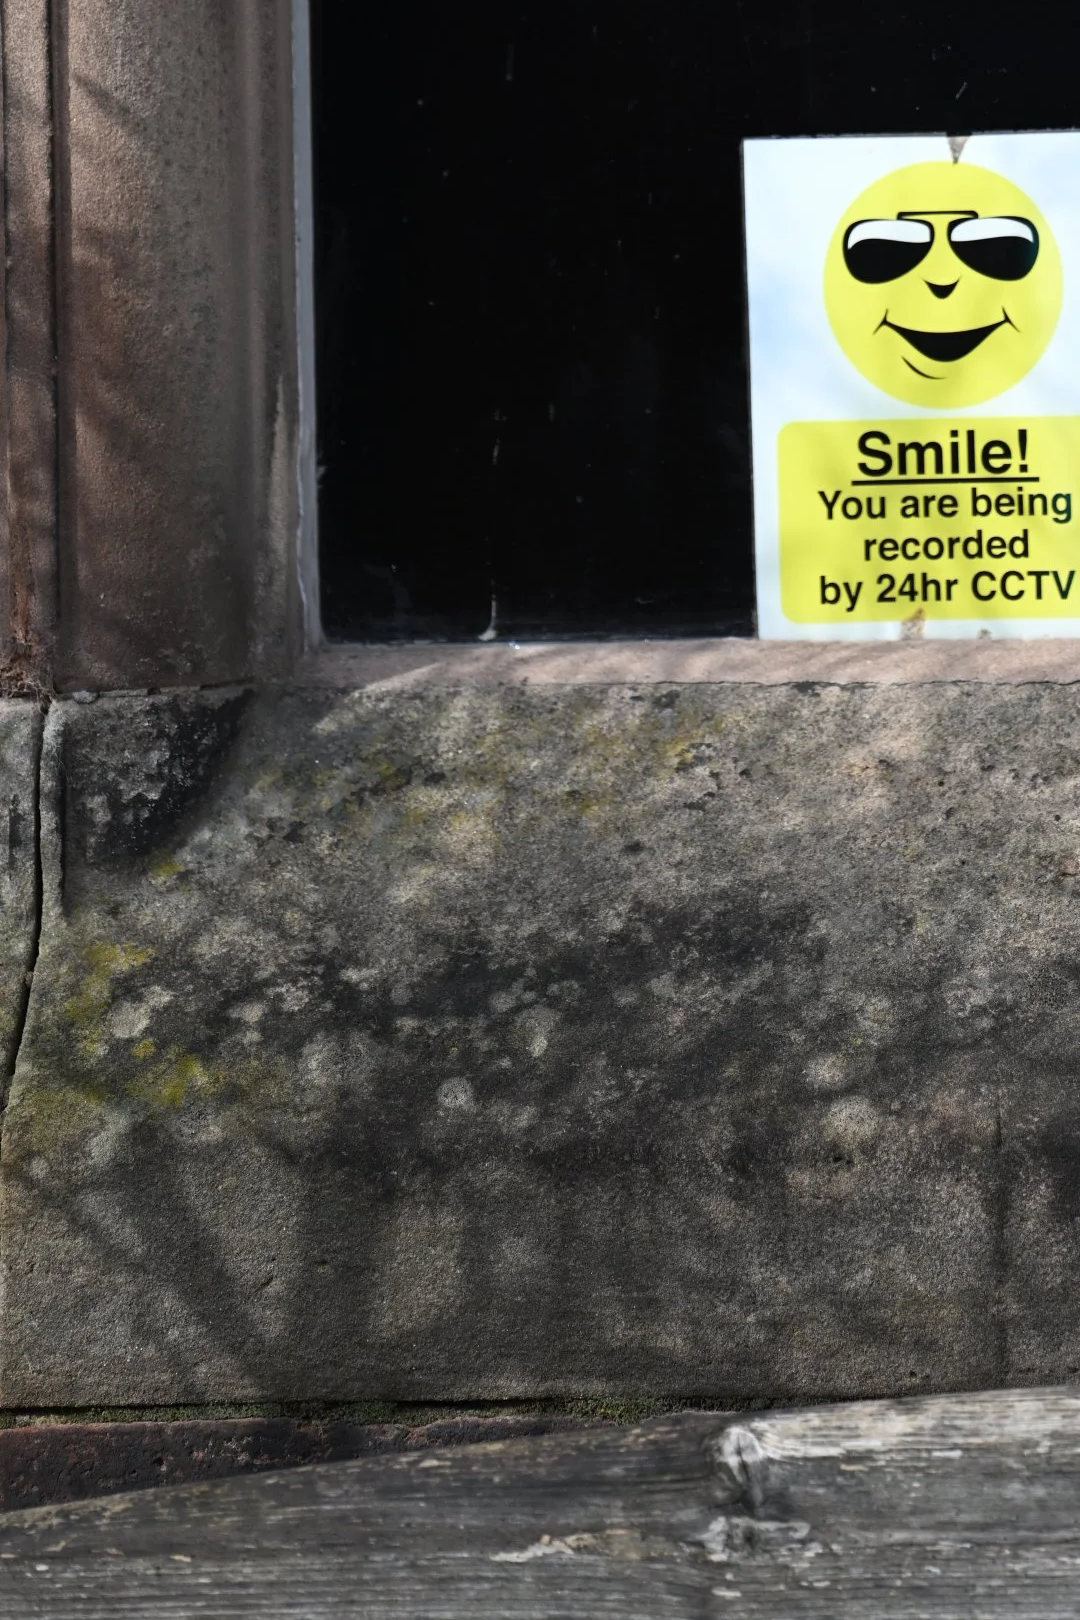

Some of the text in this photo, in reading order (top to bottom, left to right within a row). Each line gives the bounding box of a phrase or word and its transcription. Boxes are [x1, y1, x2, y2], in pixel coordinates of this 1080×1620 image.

[857, 428, 1029, 477] Smile!
[818, 486, 1072, 524] You are being
[864, 529, 1029, 561] recorded
[820, 570, 1076, 612] by 24hr CCTV
